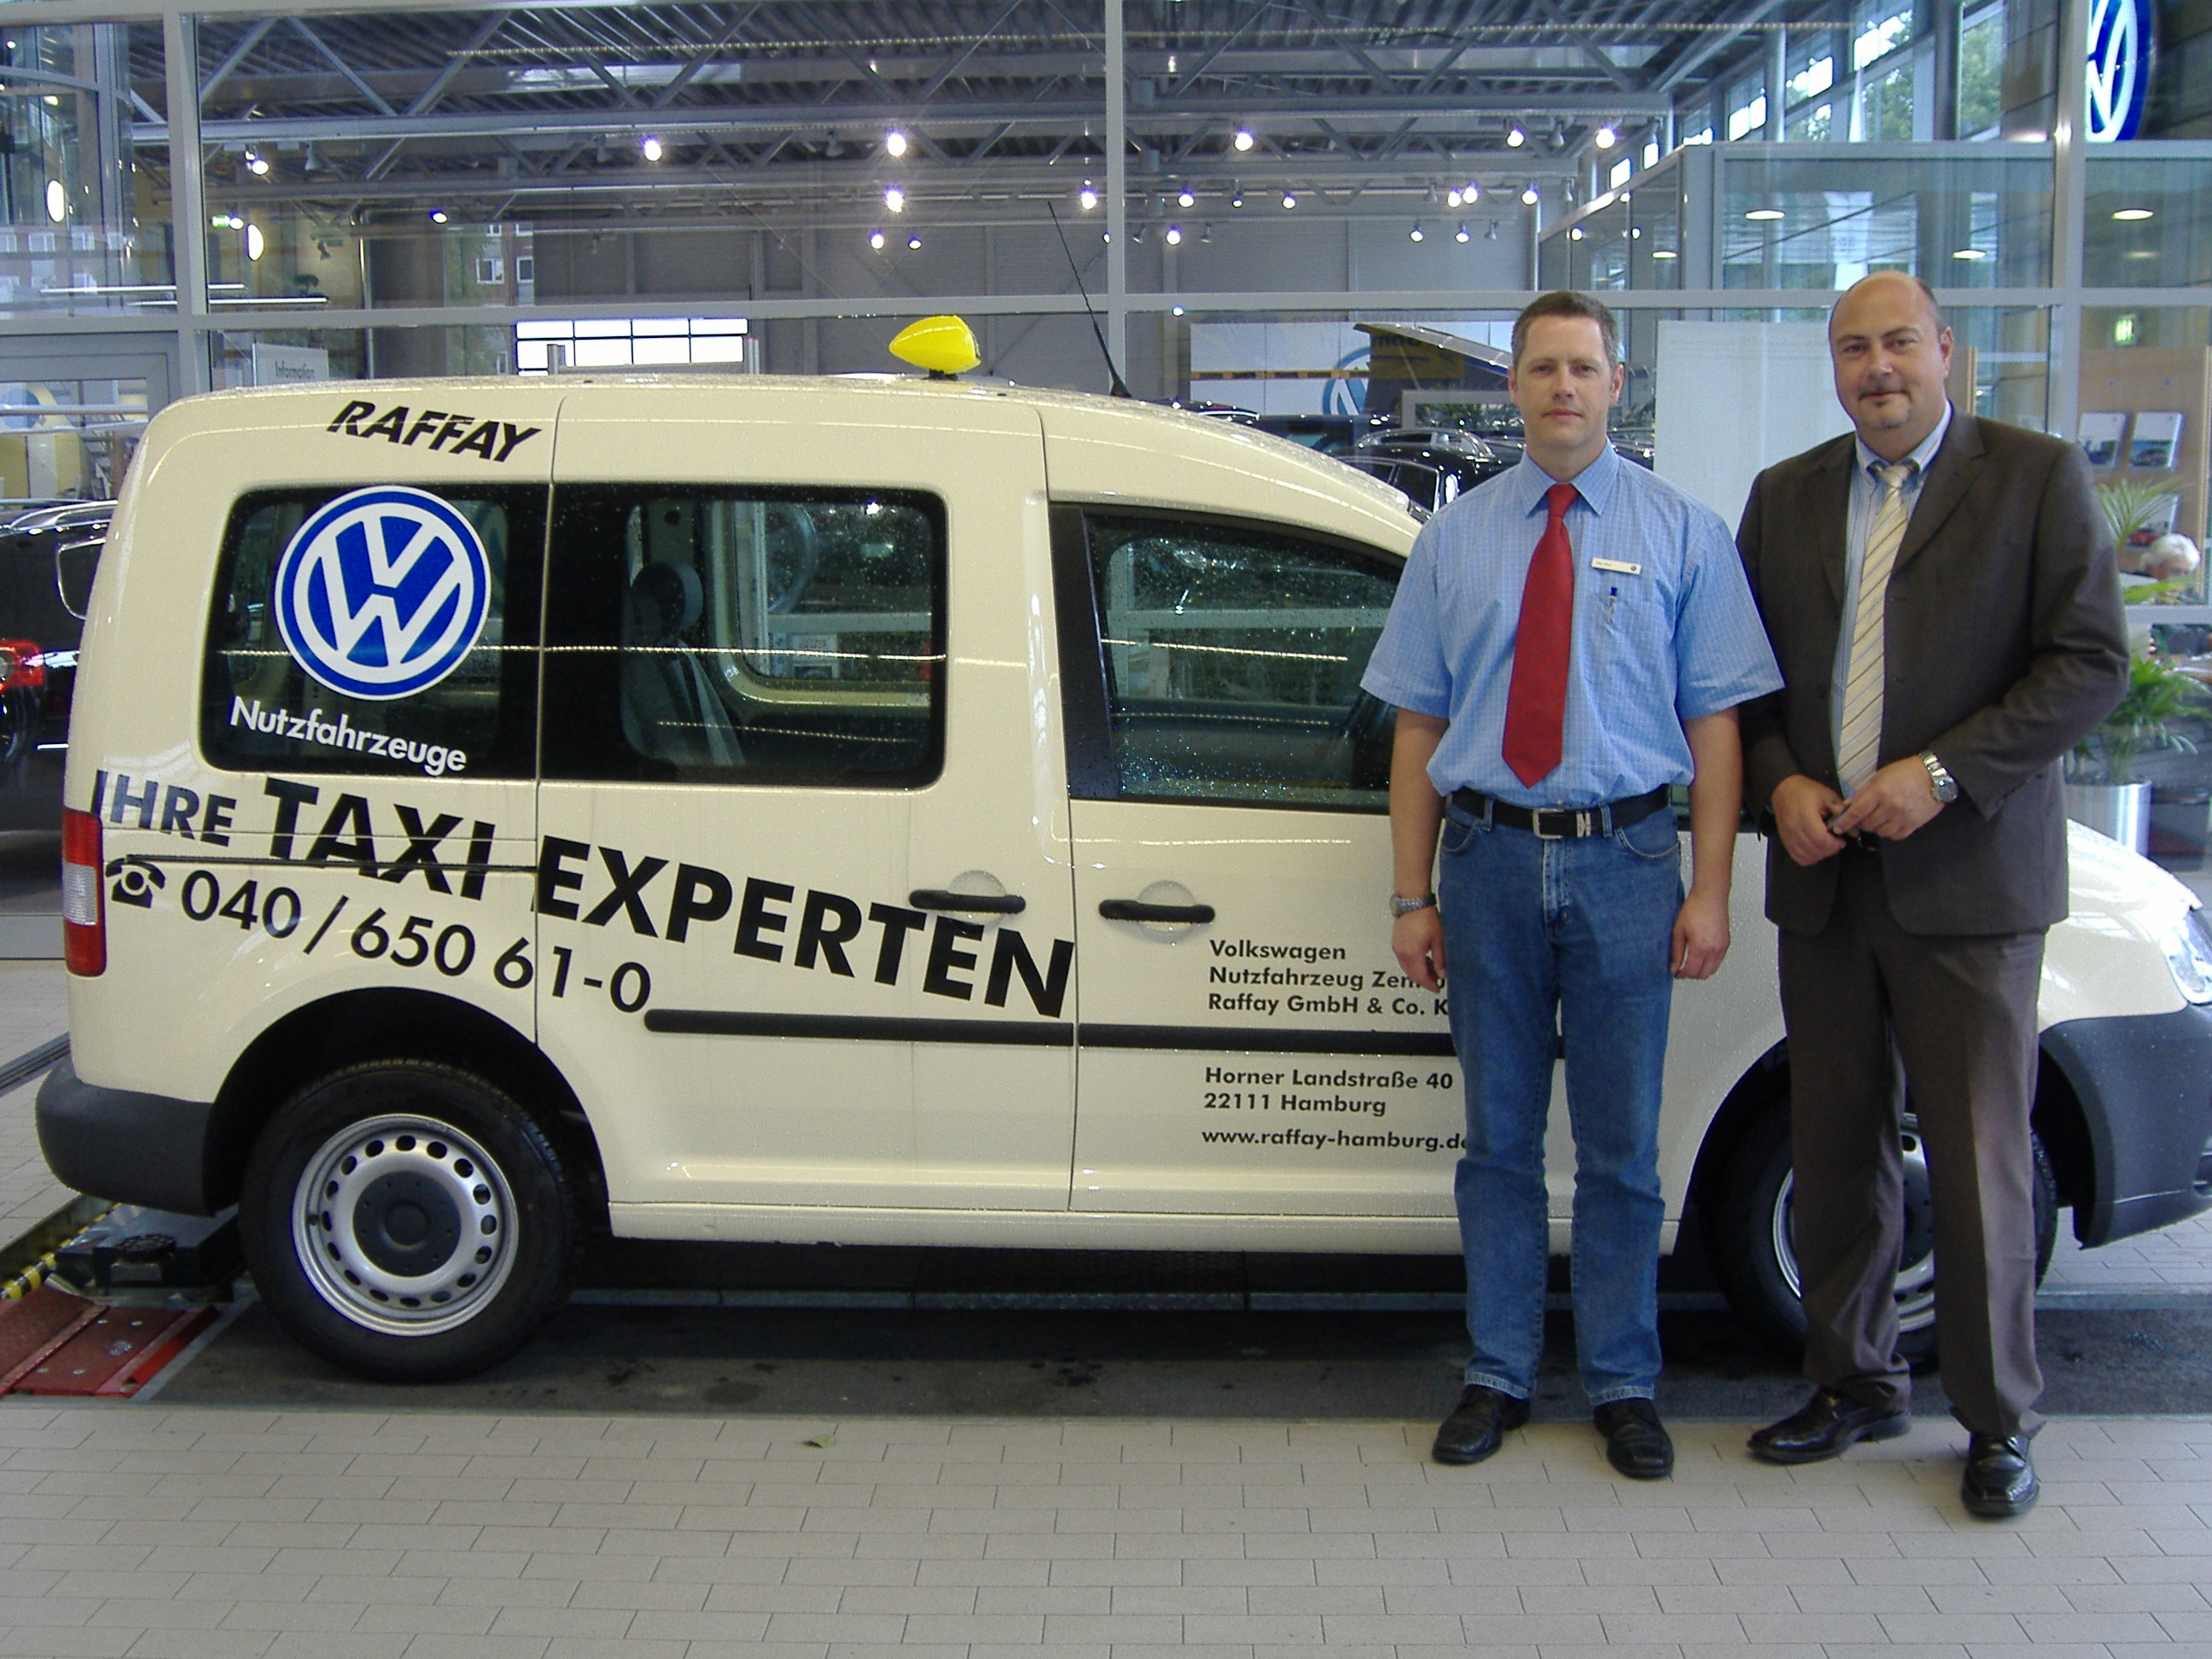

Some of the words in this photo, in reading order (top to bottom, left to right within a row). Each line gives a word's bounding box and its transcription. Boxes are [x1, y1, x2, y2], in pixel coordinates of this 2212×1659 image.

[326, 399, 543, 463] RAFFAY
[230, 696, 468, 777] Nutzfahrzeuge
[91, 770, 237, 847] IHRE
[263, 777, 497, 901] TAXI
[531, 834, 1075, 1019] EXPERTEN
[1208, 939, 1347, 964] Volkswagen
[492, 937, 652, 1013] 61-0
[1208, 966, 1365, 992] Nutzfahrzeug
[1208, 992, 1279, 1016] Raffay
[1287, 994, 1359, 1014] GmbH
[1366, 997, 1383, 1015] &
[1391, 997, 1425, 1016] Co.
[1434, 998, 1448, 1016] K
[1204, 1067, 1285, 1086] Horner
[1292, 1068, 1419, 1090] Landstraße
[1425, 1072, 1453, 1090] 40
[1203, 1092, 1270, 1110] 22111
[1280, 1094, 1387, 1117] Hamburg
